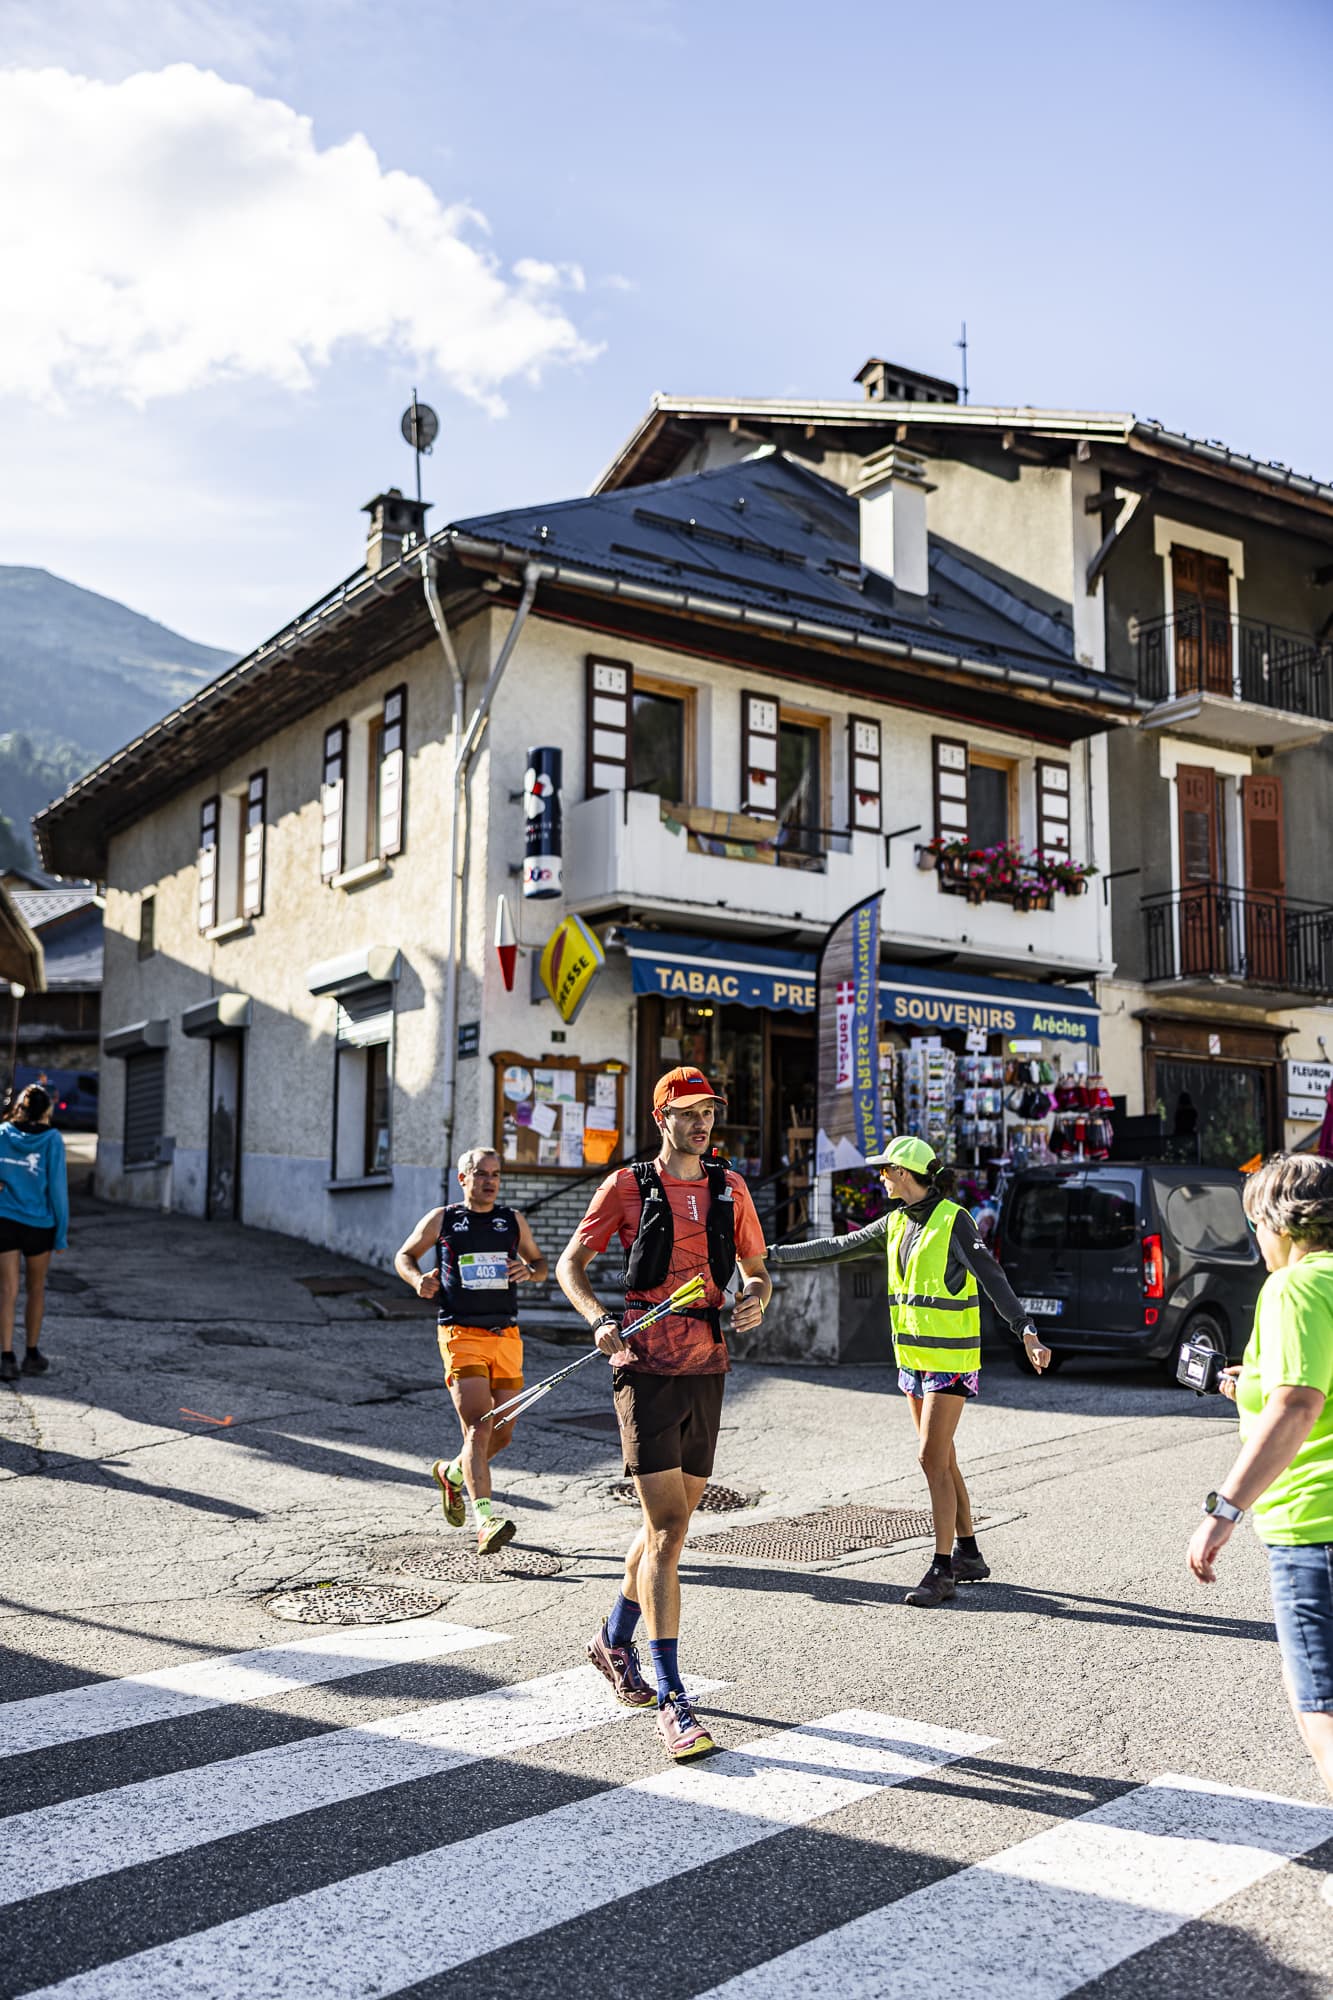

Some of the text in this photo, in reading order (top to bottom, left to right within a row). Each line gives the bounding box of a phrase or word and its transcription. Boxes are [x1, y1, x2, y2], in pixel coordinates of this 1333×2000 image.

[656, 967, 740, 998] TABAC
[773, 981, 816, 1007] PRE
[895, 997, 1016, 1030] SOUVENIRS
[1292, 1065, 1331, 1078] FLEURON
[476, 1265, 497, 1278] 403
